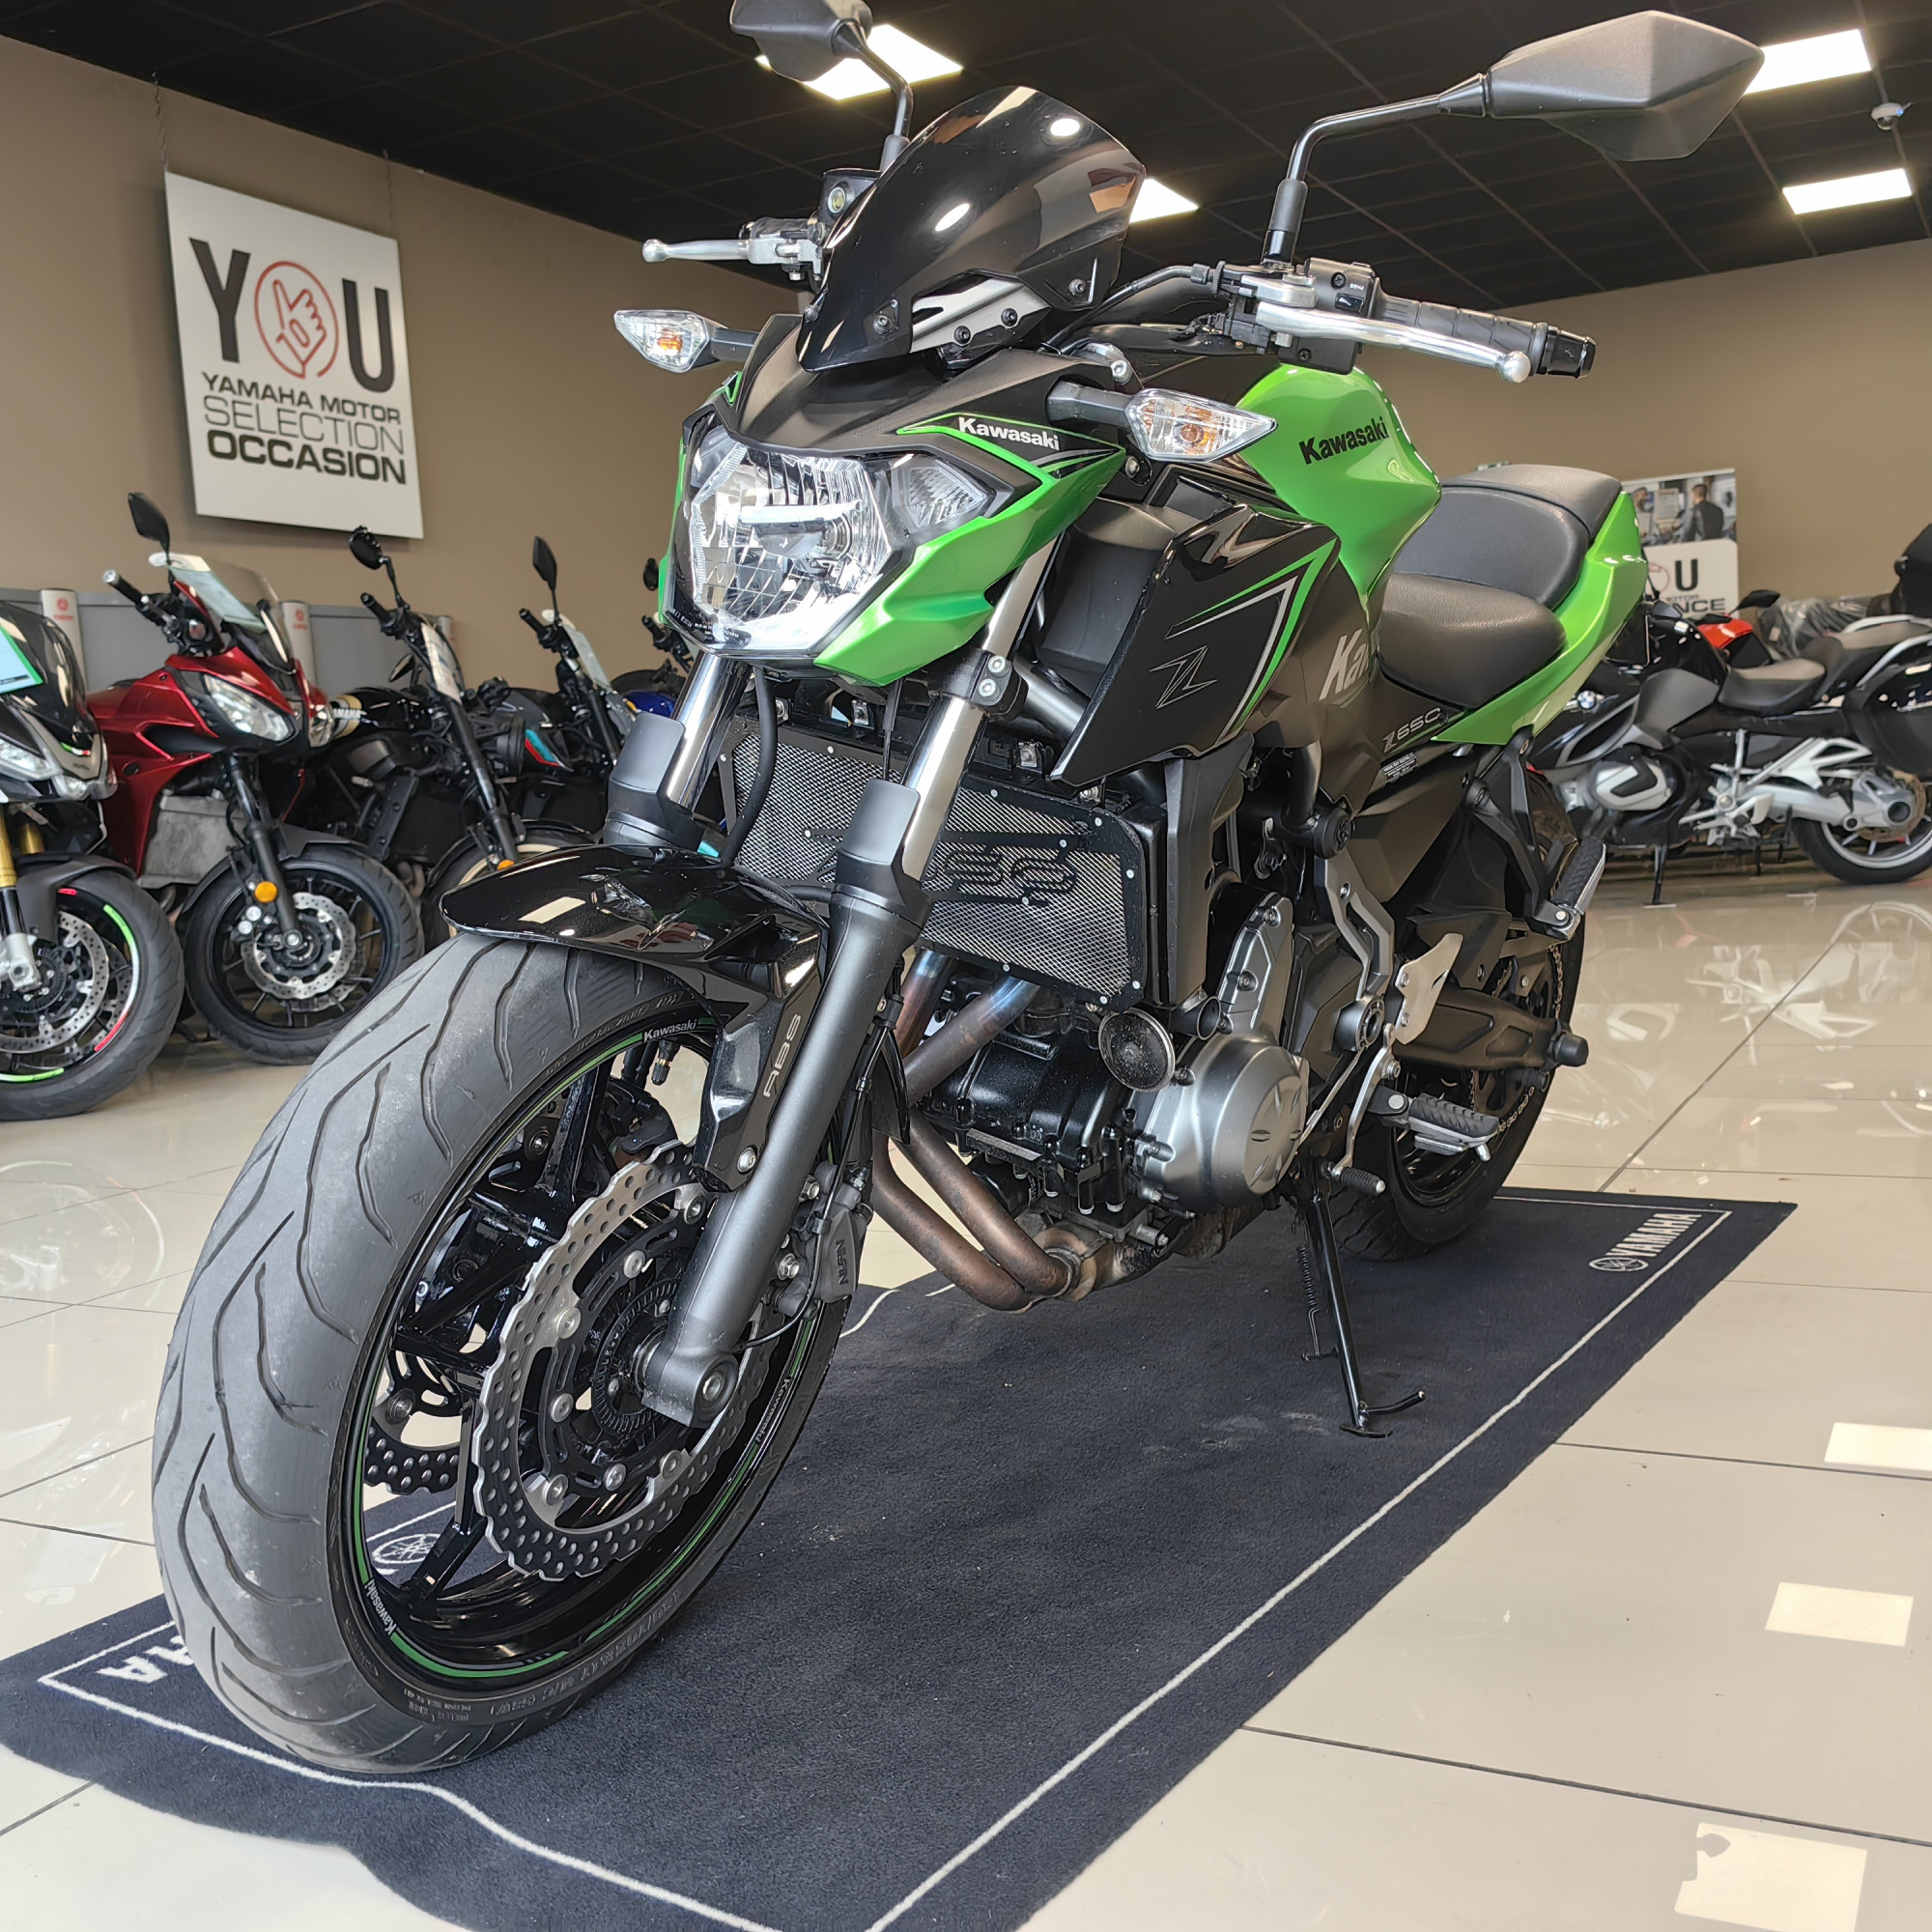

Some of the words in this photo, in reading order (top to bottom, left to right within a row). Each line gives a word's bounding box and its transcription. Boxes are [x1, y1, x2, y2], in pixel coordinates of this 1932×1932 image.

[202, 371, 313, 409] YAMAHA
[321, 394, 401, 425] MOTOR
[204, 395, 404, 455] SELECTION
[207, 429, 406, 485] OCCASION
[958, 416, 1060, 451] Kawasaki
[1298, 416, 1390, 466] Kawasaki
[643, 1018, 697, 1043] Kawasaki
[763, 1014, 801, 1097] ABS
[1605, 1213, 1703, 1257] YAMAHA
[363, 1579, 397, 1635] Kawasaki
